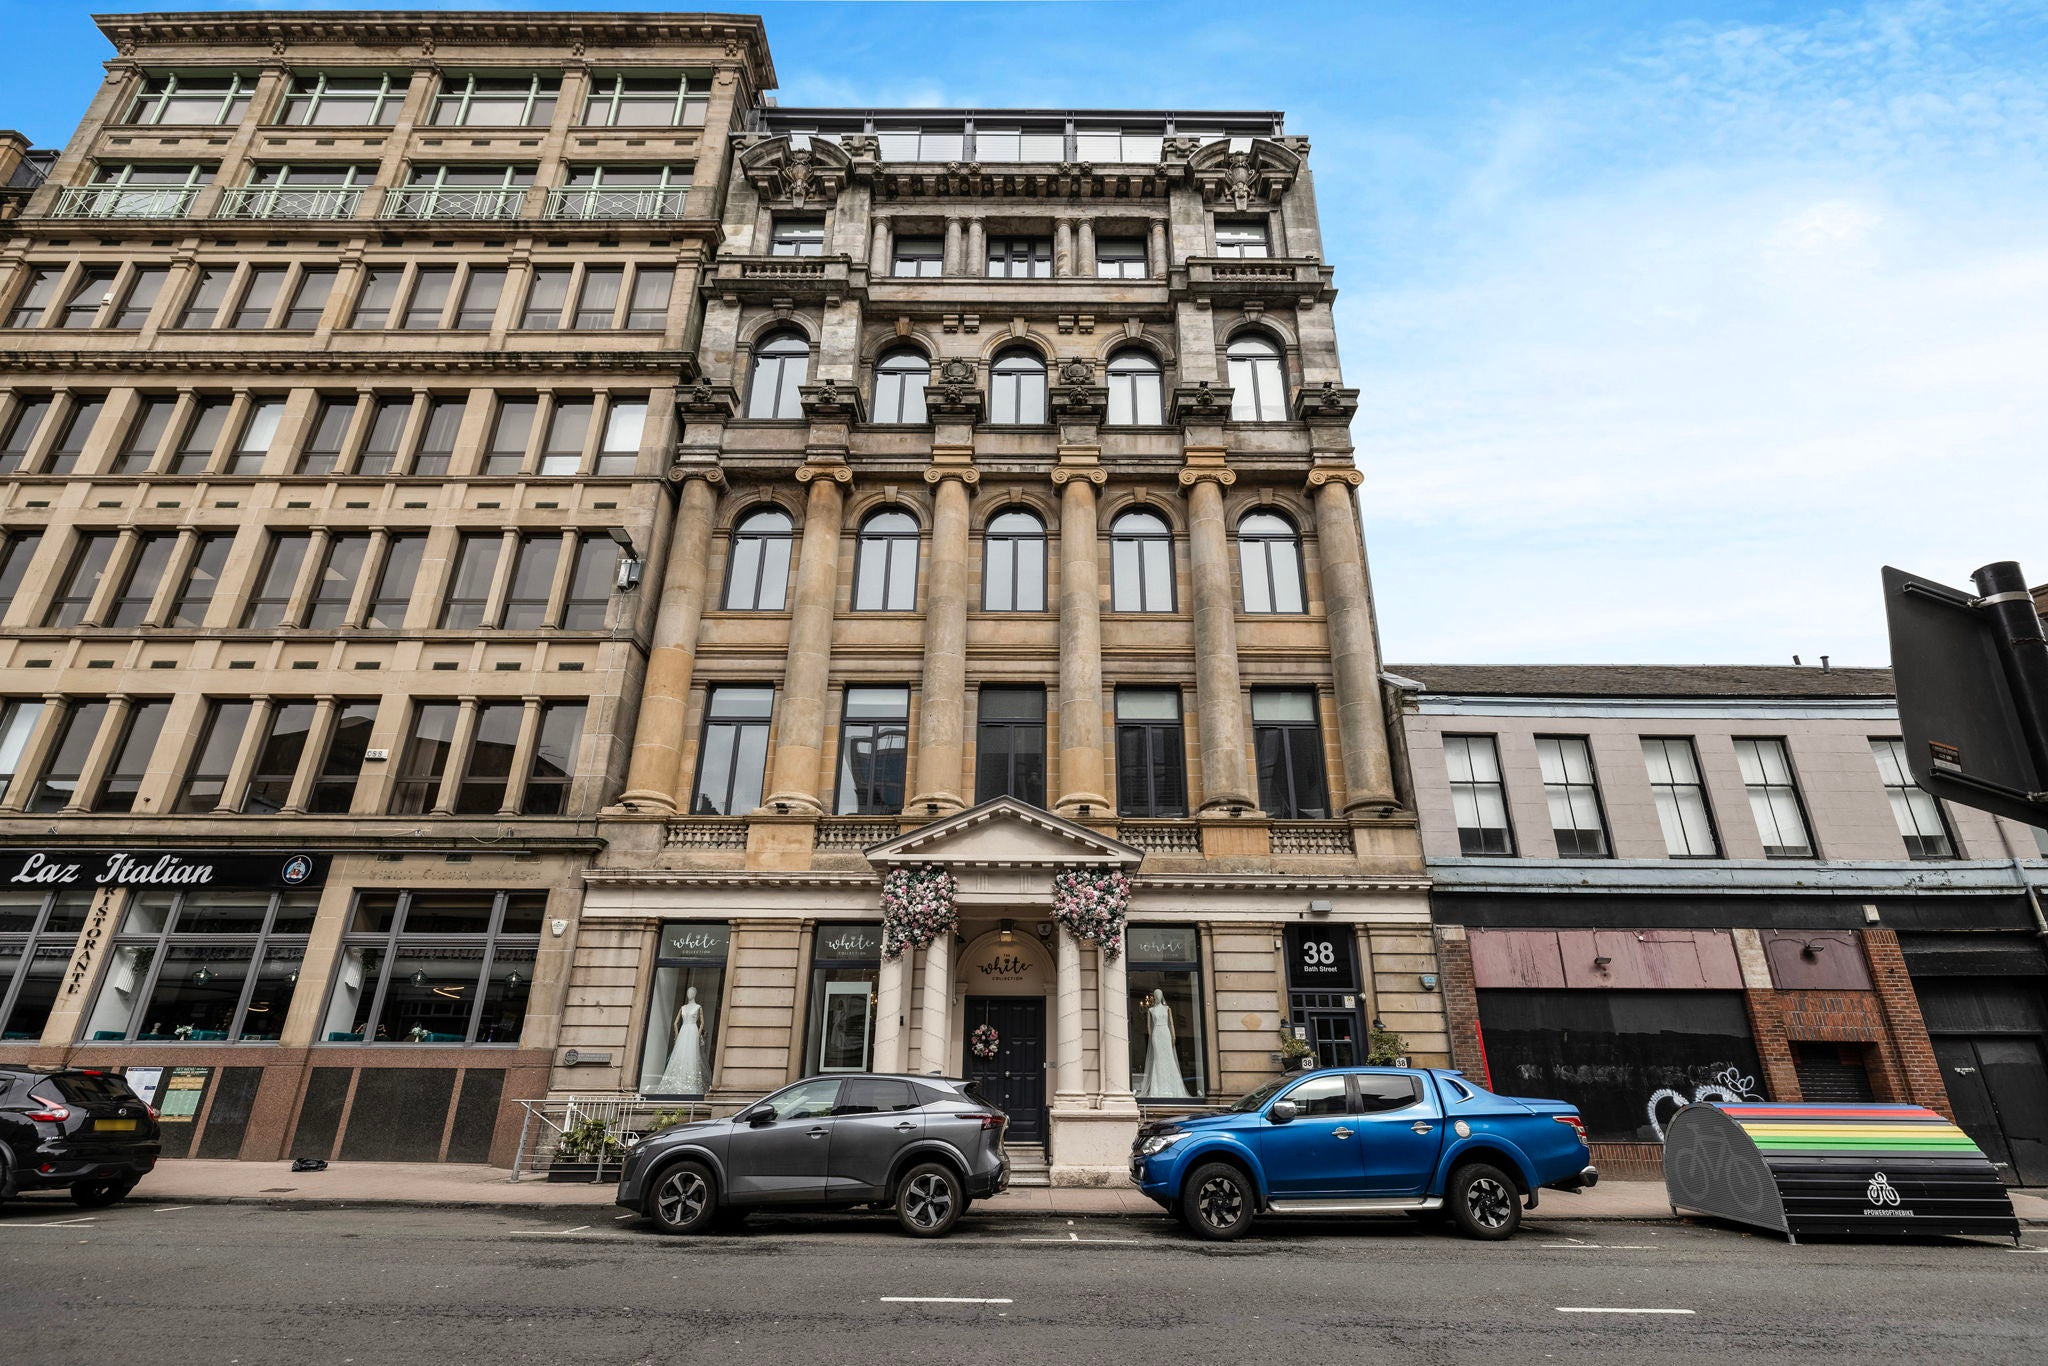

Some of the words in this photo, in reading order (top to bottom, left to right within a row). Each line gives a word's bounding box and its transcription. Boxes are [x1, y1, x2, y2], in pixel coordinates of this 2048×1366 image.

[10, 853, 80, 883] Laz
[95, 853, 214, 884] Italian
[670, 932, 721, 949] white
[825, 933, 873, 950] white
[1303, 941, 1335, 965] 38
[976, 956, 1032, 975] white
[1303, 1059, 1312, 1067] 38
[1396, 1059, 1406, 1067] 38
